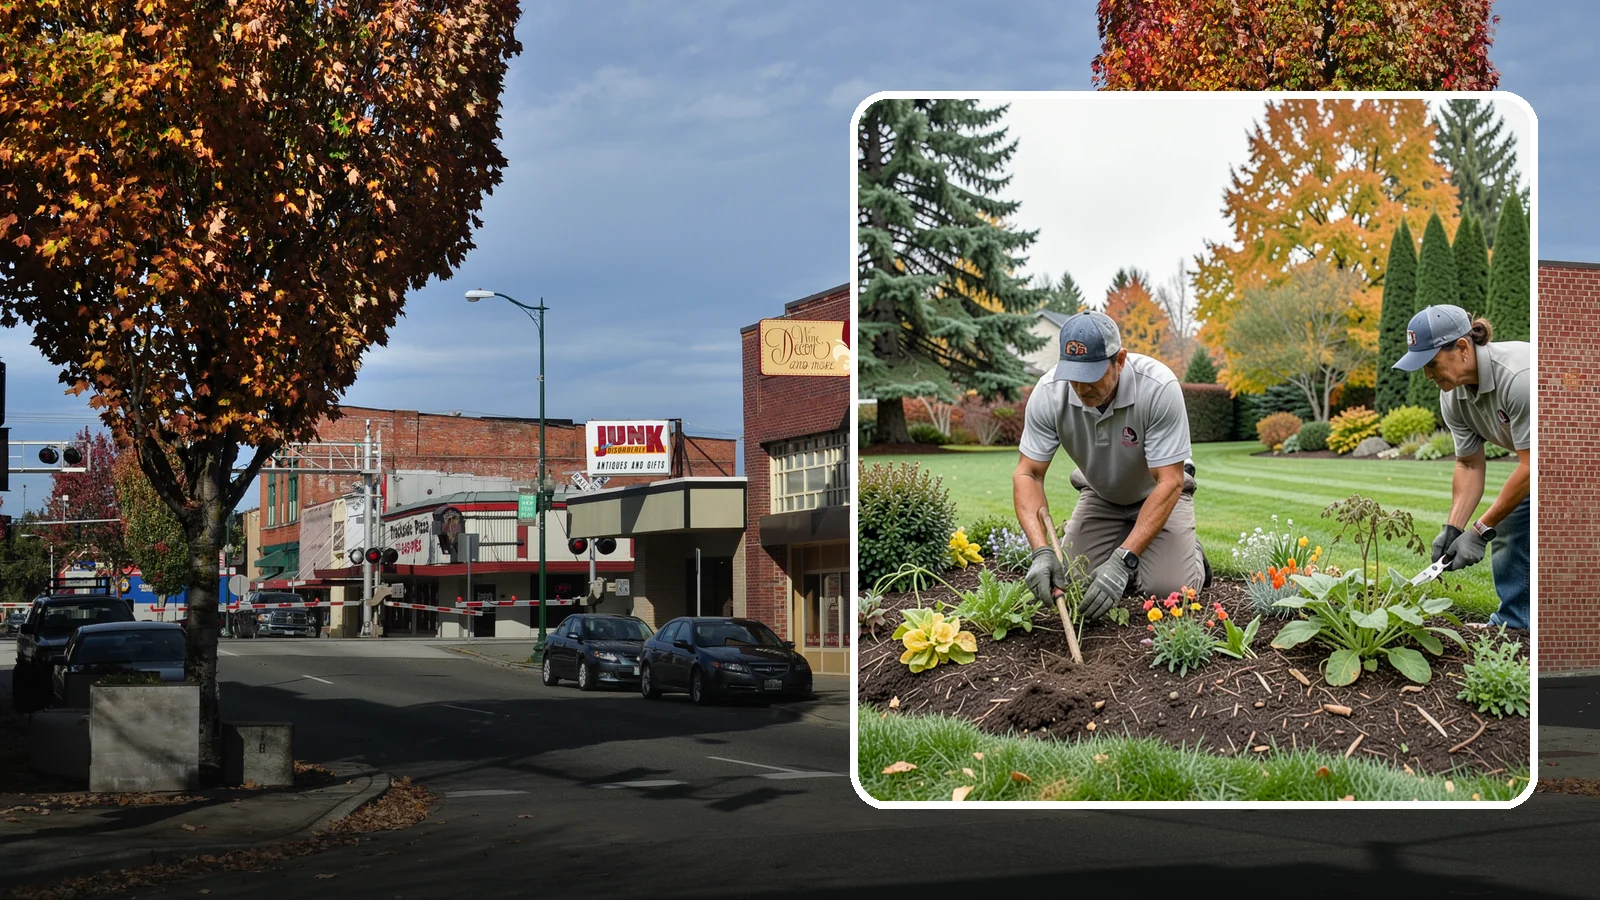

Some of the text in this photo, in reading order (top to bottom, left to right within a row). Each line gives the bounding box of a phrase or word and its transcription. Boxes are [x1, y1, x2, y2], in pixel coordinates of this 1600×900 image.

[765, 327, 831, 365] Decor
[595, 425, 665, 457] JUNK
[607, 446, 646, 454] DISORDERLY
[597, 460, 665, 470] ANTIQUES AND GIFTS
[390, 520, 429, 539] Trackside Pizza
